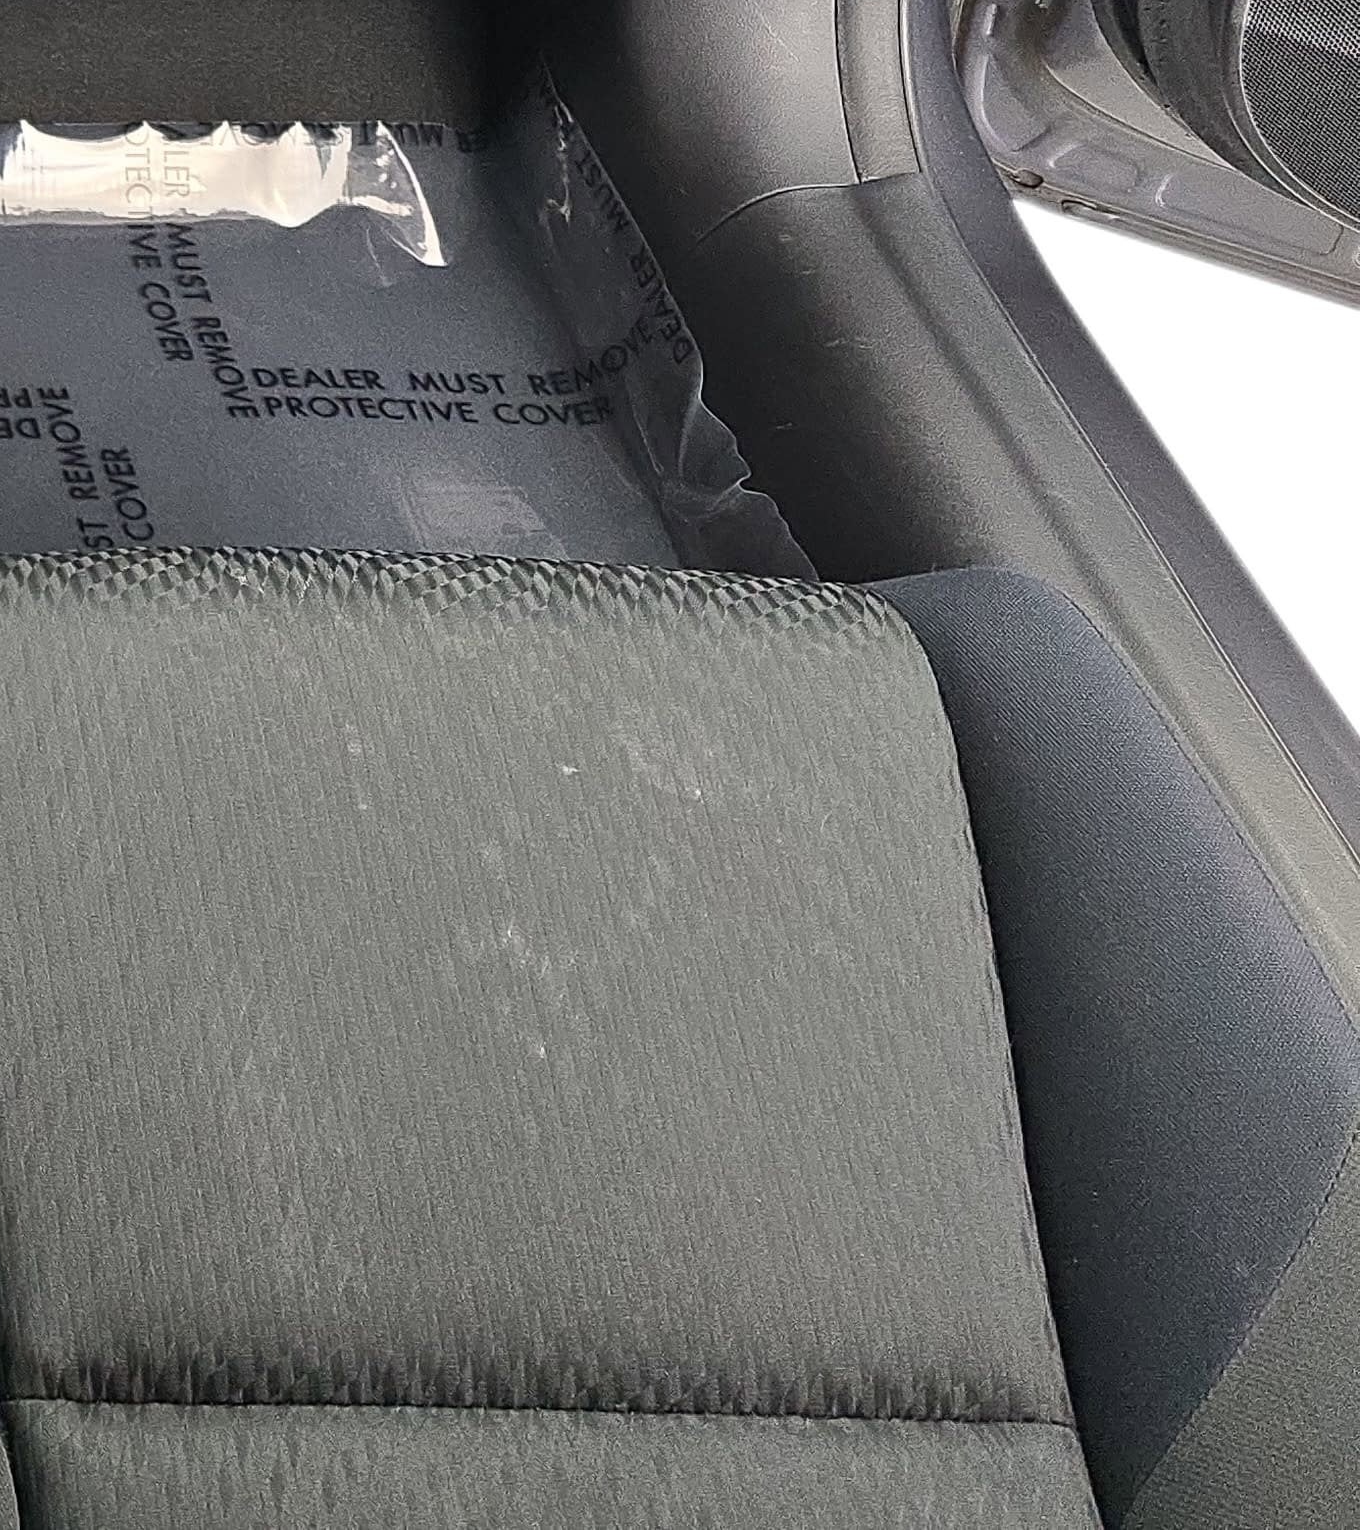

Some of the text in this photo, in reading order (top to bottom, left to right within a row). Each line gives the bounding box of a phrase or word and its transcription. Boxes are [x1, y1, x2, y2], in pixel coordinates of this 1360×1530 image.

[138, 279, 194, 364] COVER
[166, 222, 209, 303] MUST
[191, 313, 260, 420] REMOVE
[248, 313, 658, 398] DEALER MUST REMOVE
[44, 384, 102, 503] REMOVE
[264, 394, 613, 429] PROTECTIVE COVER
[99, 446, 156, 542] COVER
